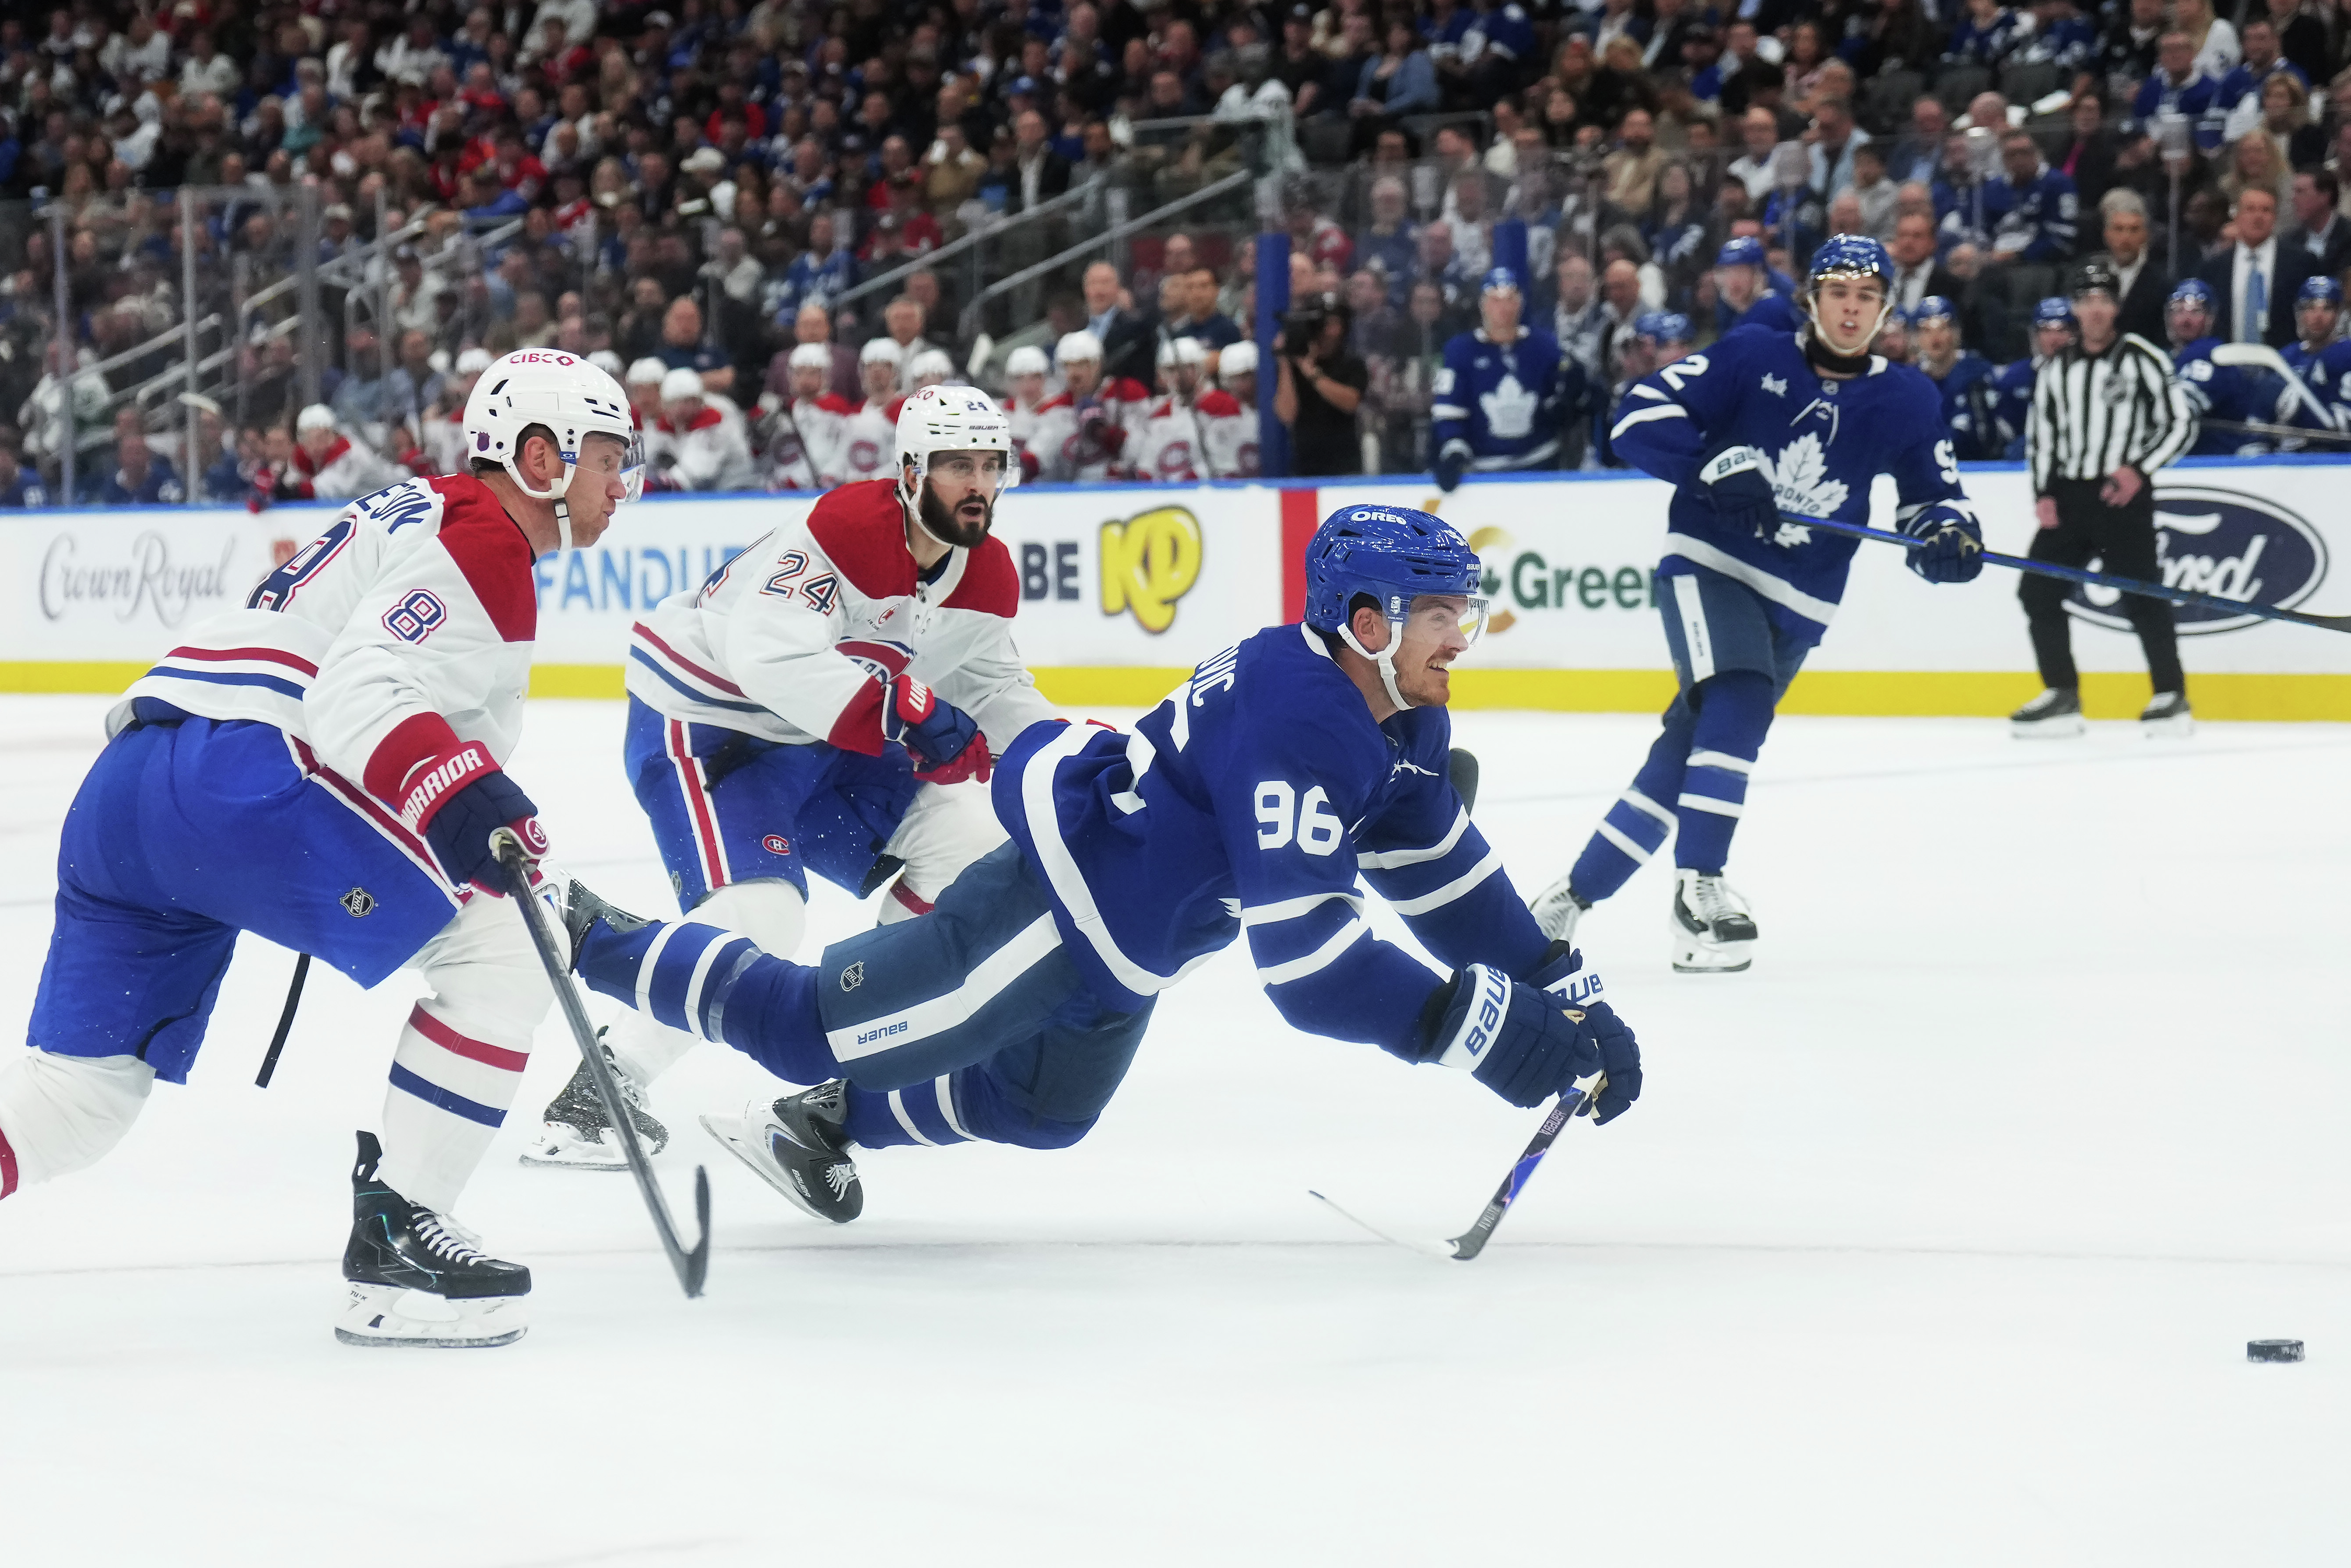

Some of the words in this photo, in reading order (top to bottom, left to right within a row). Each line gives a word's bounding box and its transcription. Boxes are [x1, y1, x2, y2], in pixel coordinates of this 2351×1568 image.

[510, 353, 554, 364] CIBC
[1351, 511, 1407, 525] OREO
[1775, 482, 1820, 513] RONTO
[39, 532, 131, 621] Crown
[113, 529, 236, 628] Royal
[535, 547, 748, 610] FANDU
[760, 549, 839, 617] 24
[1022, 542, 1080, 602] BE
[1511, 550, 1660, 609] Gree
[382, 589, 446, 644] 8
[401, 748, 484, 825] WARRIOR
[1254, 781, 1344, 856] 96
[353, 894, 362, 913] NHL
[845, 970, 858, 983] NHL
[857, 1021, 908, 1045] BAUER
[1464, 966, 1506, 1057] BAUE
[792, 1169, 811, 1198] BAUER
